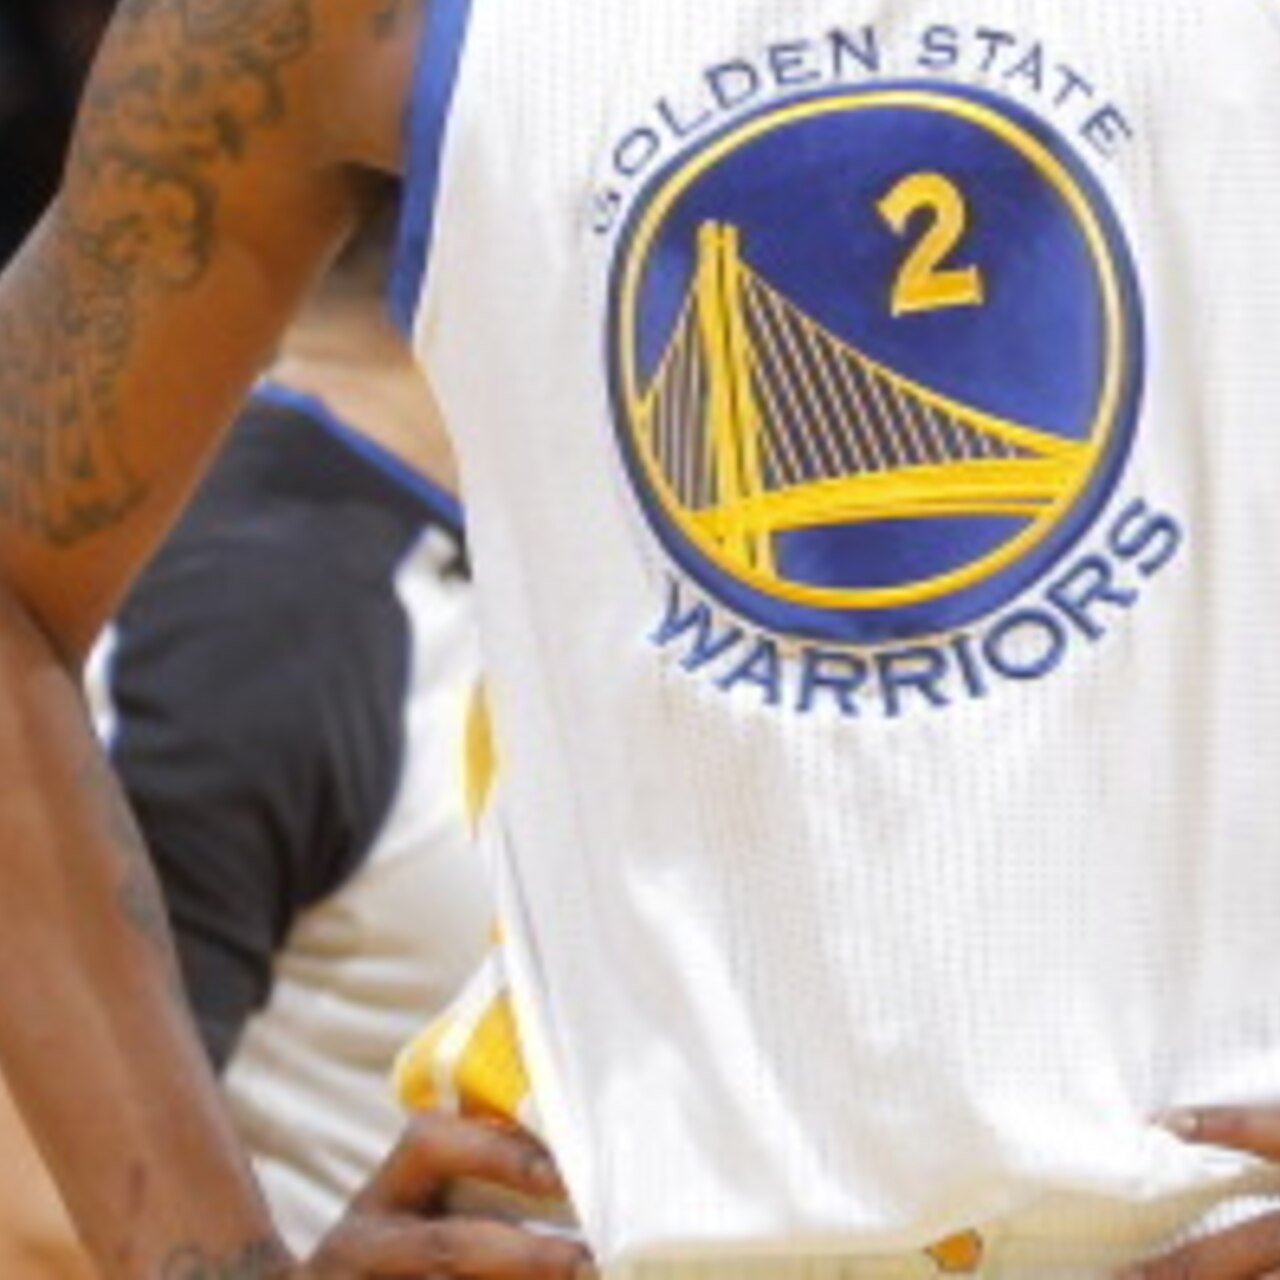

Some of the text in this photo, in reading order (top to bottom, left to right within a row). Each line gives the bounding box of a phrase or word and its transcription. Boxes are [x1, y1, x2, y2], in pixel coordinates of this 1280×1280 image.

[591, 23, 1133, 235] GOLDEN STATE
[875, 171, 984, 317] 2
[648, 496, 1183, 718] WARRIORS
